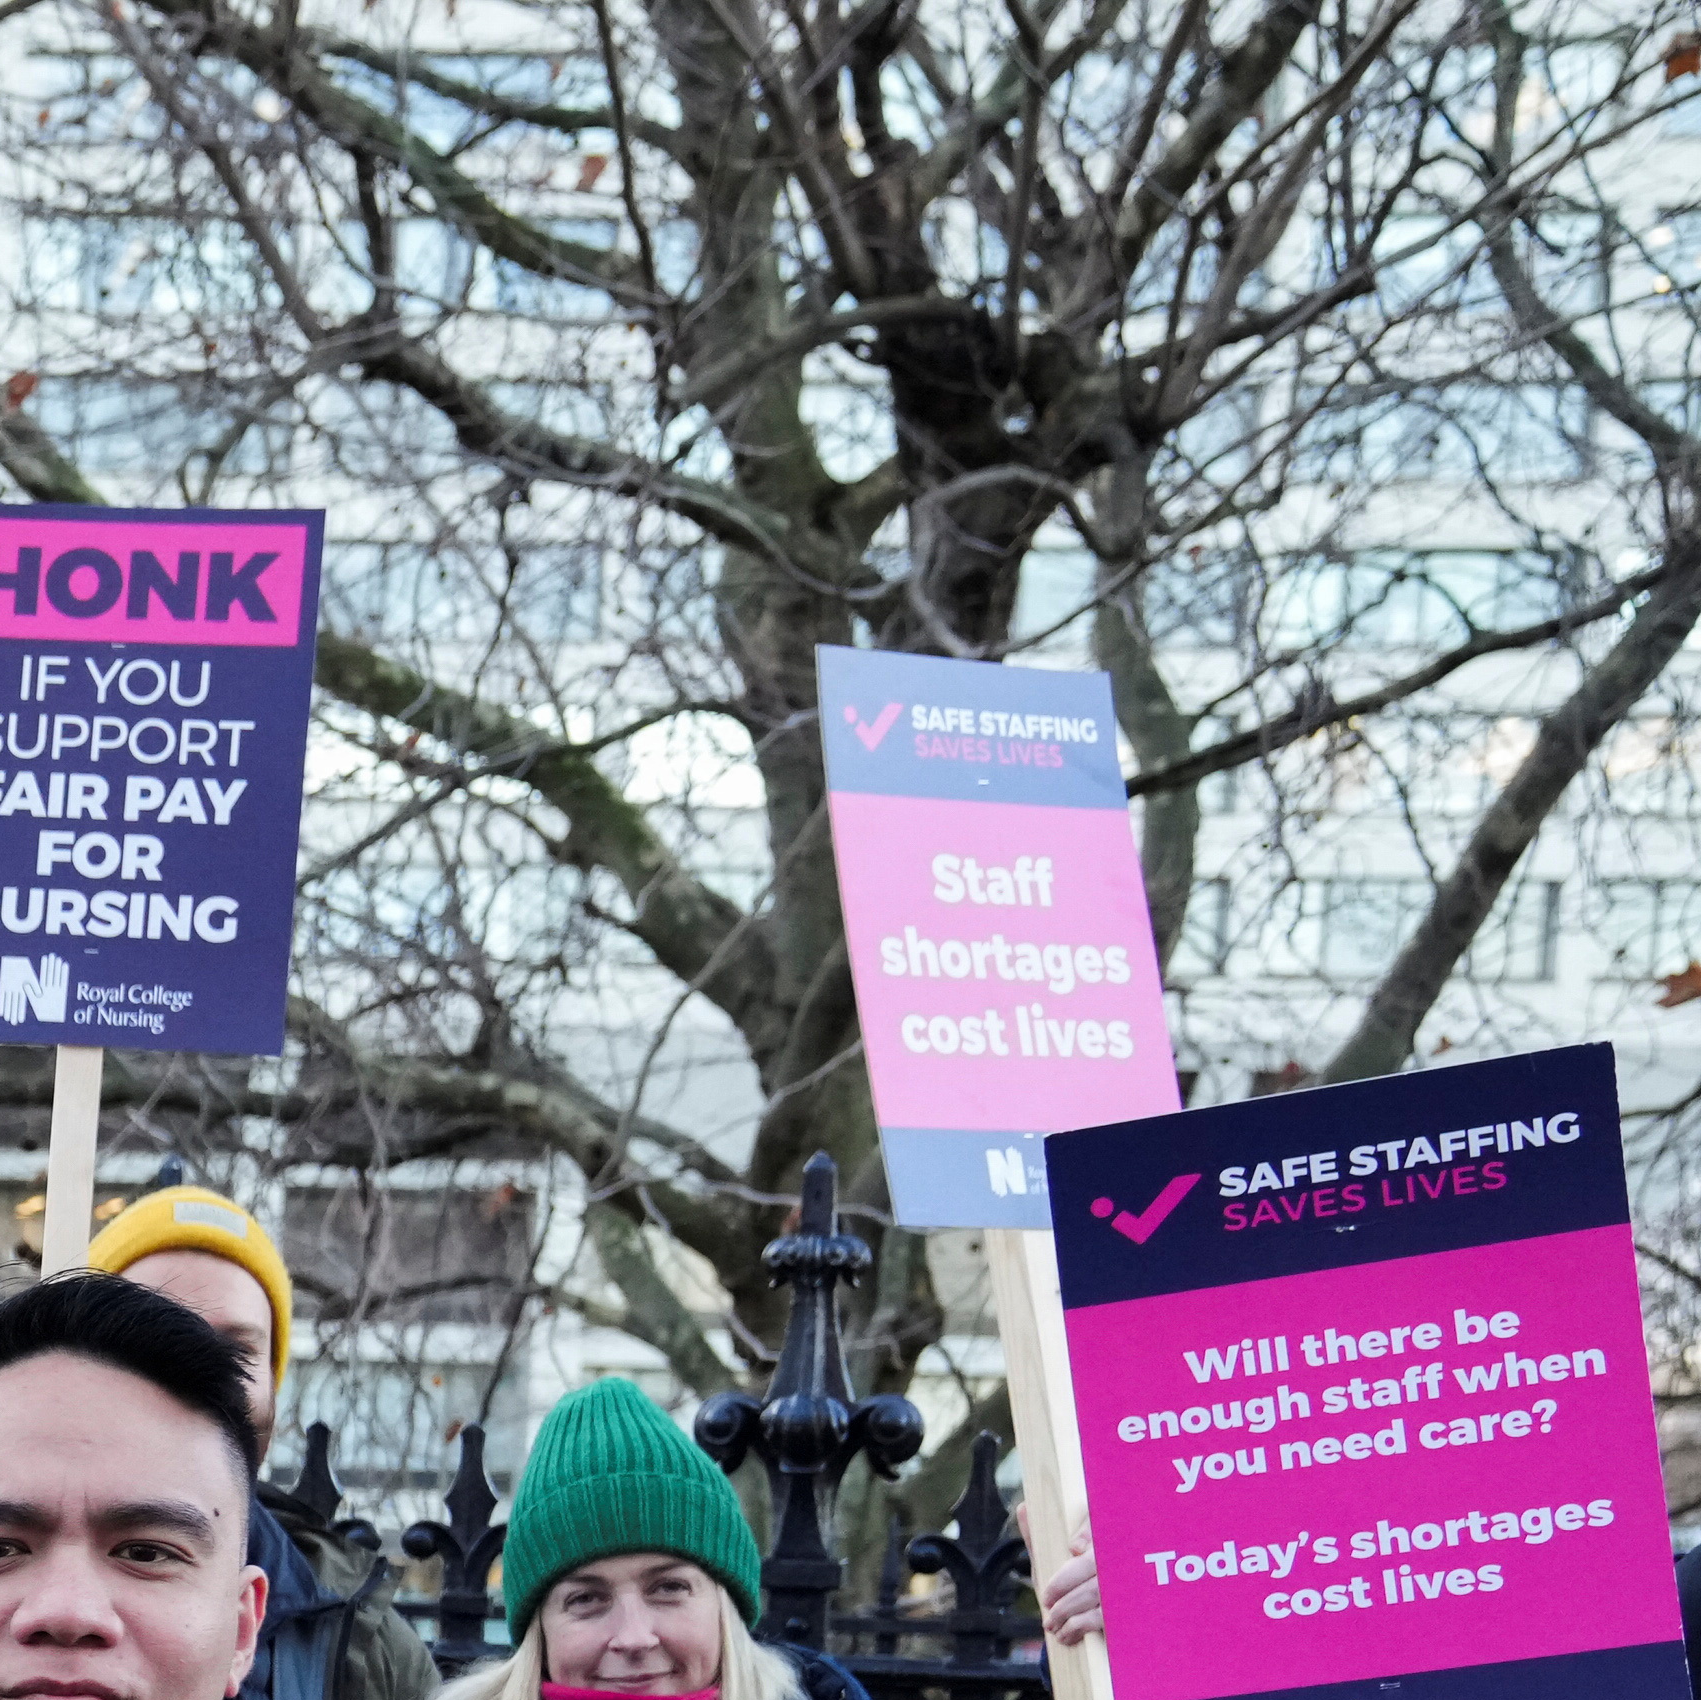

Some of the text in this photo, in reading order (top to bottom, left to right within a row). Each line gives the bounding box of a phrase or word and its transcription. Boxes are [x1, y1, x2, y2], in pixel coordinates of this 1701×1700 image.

[20, 654, 211, 708] IF YOU
[911, 703, 1098, 744] SAFE STAFFING
[914, 735, 1064, 769] SAVES LIVES
[123, 775, 248, 826] PAY
[36, 830, 165, 882] FOR
[932, 853, 1053, 907] Staff
[880, 926, 1131, 994] shortages
[73, 1004, 165, 1035] of Nursing
[77, 981, 193, 1012] Royal College
[901, 1004, 1135, 1059] cost lives
[1219, 1112, 1580, 1197] SAFE STAFFING
[1223, 1161, 1507, 1231] SAVES LIVES
[1183, 1308, 1520, 1384] Will there be
[1117, 1346, 1607, 1443] enough staff when
[1172, 1398, 1558, 1493] you need care?
[1144, 1498, 1615, 1586] Today's shortages
[1262, 1563, 1504, 1619] cost lives
